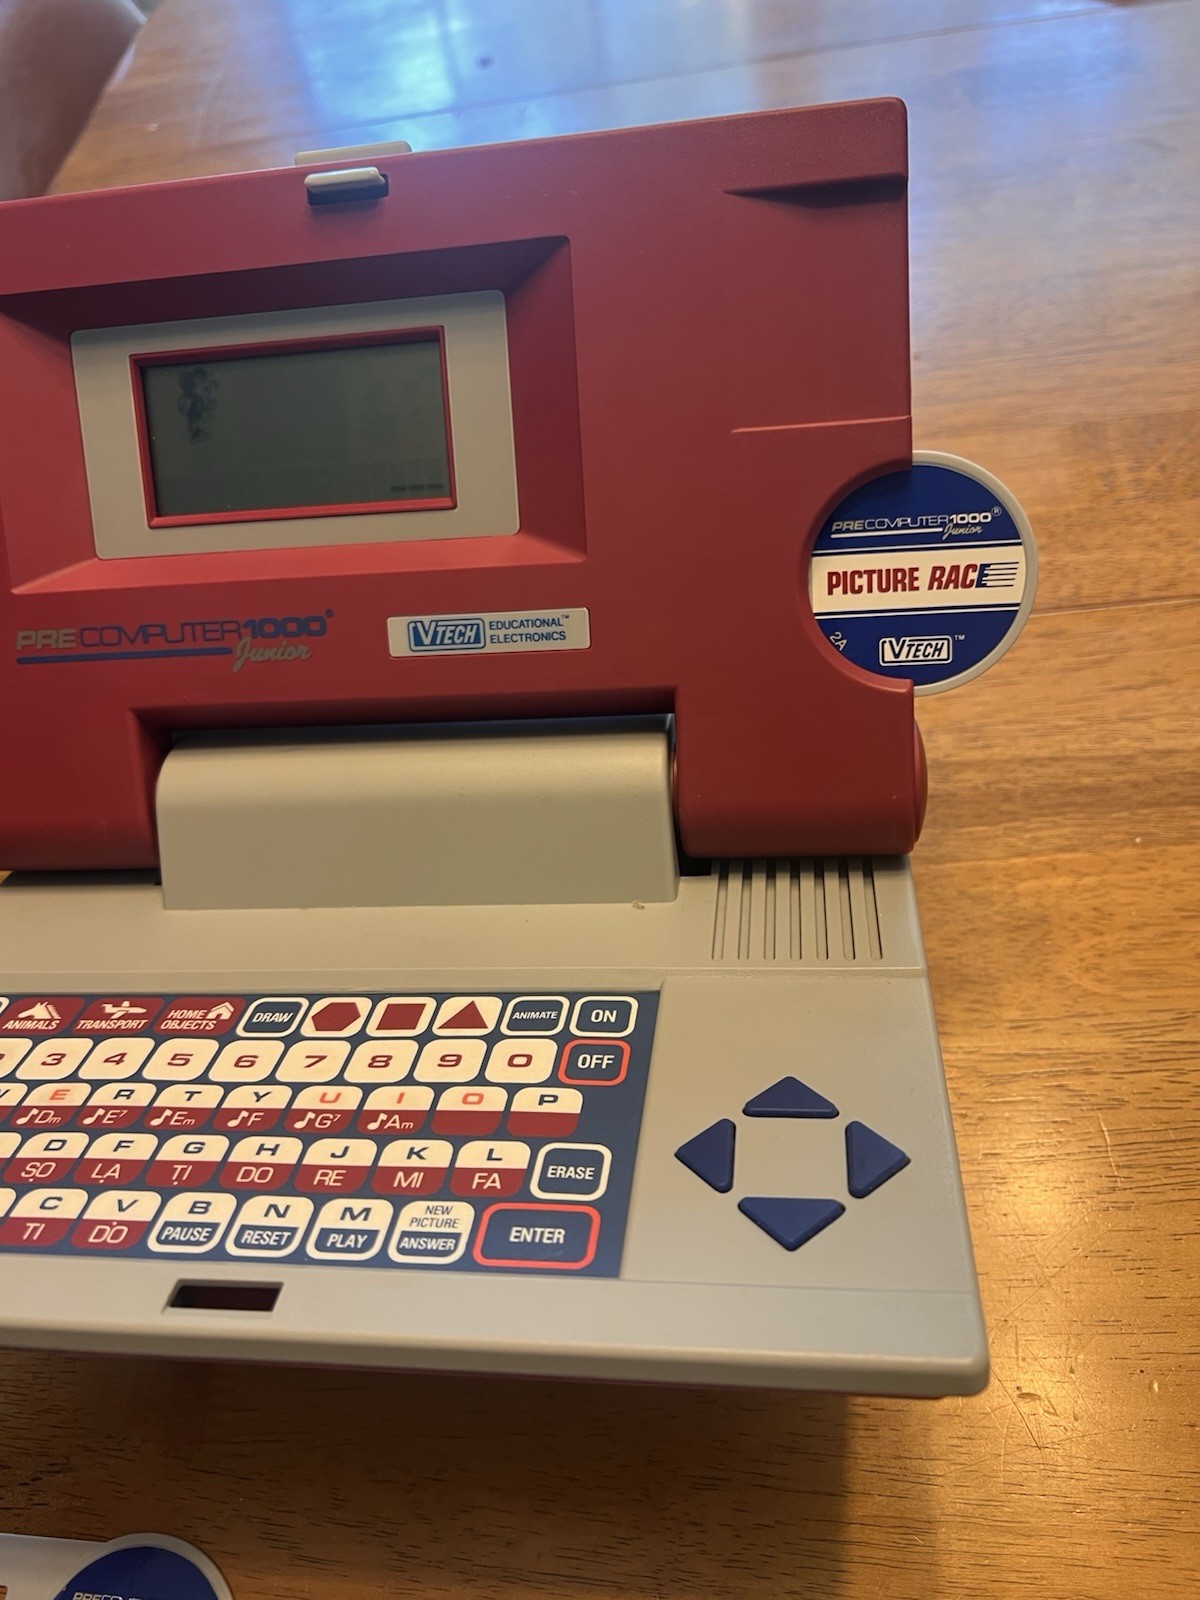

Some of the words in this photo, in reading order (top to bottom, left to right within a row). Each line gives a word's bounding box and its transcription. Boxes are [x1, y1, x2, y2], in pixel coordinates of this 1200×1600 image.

[941, 523, 983, 541] Junior
[827, 566, 920, 596] PICTURE
[927, 563, 996, 591] RACE
[489, 617, 564, 631] EDUCATIONAL
[415, 620, 479, 646] VTECH
[490, 631, 567, 644] ELECTRONICS
[829, 631, 848, 651] 2A
[232, 636, 312, 673] Junior
[888, 638, 945, 660] VTECH
[167, 1008, 207, 1019] HOME
[251, 1011, 293, 1023] DRAW
[512, 1010, 558, 1020] ANIMATE
[590, 1009, 617, 1023] ON
[2, 1019, 60, 1030] ANIMALS
[76, 1018, 149, 1030] TRANSPORT
[160, 1019, 217, 1031] OBJECTS
[41, 1053, 67, 1066] 3
[103, 1052, 128, 1066] 4
[167, 1053, 194, 1067] 5
[233, 1054, 259, 1068] 6
[303, 1055, 327, 1069] 7
[367, 1054, 393, 1068] 8
[437, 1053, 463, 1067] 9
[506, 1053, 533, 1067] 0
[577, 1054, 615, 1069] OFF
[49, 1089, 71, 1101] E
[113, 1088, 135, 1100] R
[184, 1090, 203, 1102] T
[252, 1091, 272, 1103] Y
[318, 1091, 343, 1104] U
[396, 1092, 405, 1104] I
[461, 1092, 485, 1105] O
[538, 1094, 559, 1106] P
[34, 1109, 62, 1124] Dm
[169, 1110, 196, 1126] Em
[247, 1111, 264, 1126] F
[383, 1113, 414, 1130] Am
[43, 1139, 68, 1151] D
[113, 1140, 136, 1152] F
[182, 1141, 206, 1154] G
[255, 1143, 281, 1156] H
[330, 1145, 350, 1159] J
[406, 1146, 430, 1161] K
[486, 1148, 503, 1161] L
[235, 1166, 274, 1184] DO
[313, 1169, 347, 1186] RE
[393, 1171, 424, 1188] MI
[546, 1165, 595, 1180] ERASE
[471, 1172, 502, 1190] FA
[39, 1196, 63, 1210] C
[116, 1199, 139, 1212] V
[188, 1200, 212, 1214] B
[263, 1203, 291, 1218] N
[340, 1207, 372, 1222] M
[424, 1205, 454, 1216] NEW
[409, 1216, 461, 1229] PICTURE
[22, 1222, 46, 1241] TI
[160, 1226, 213, 1242] PAUSE
[240, 1229, 292, 1246] RESET
[509, 1226, 566, 1244] ENTER
[326, 1233, 369, 1249] PLAY
[399, 1236, 456, 1251] ANSWER
